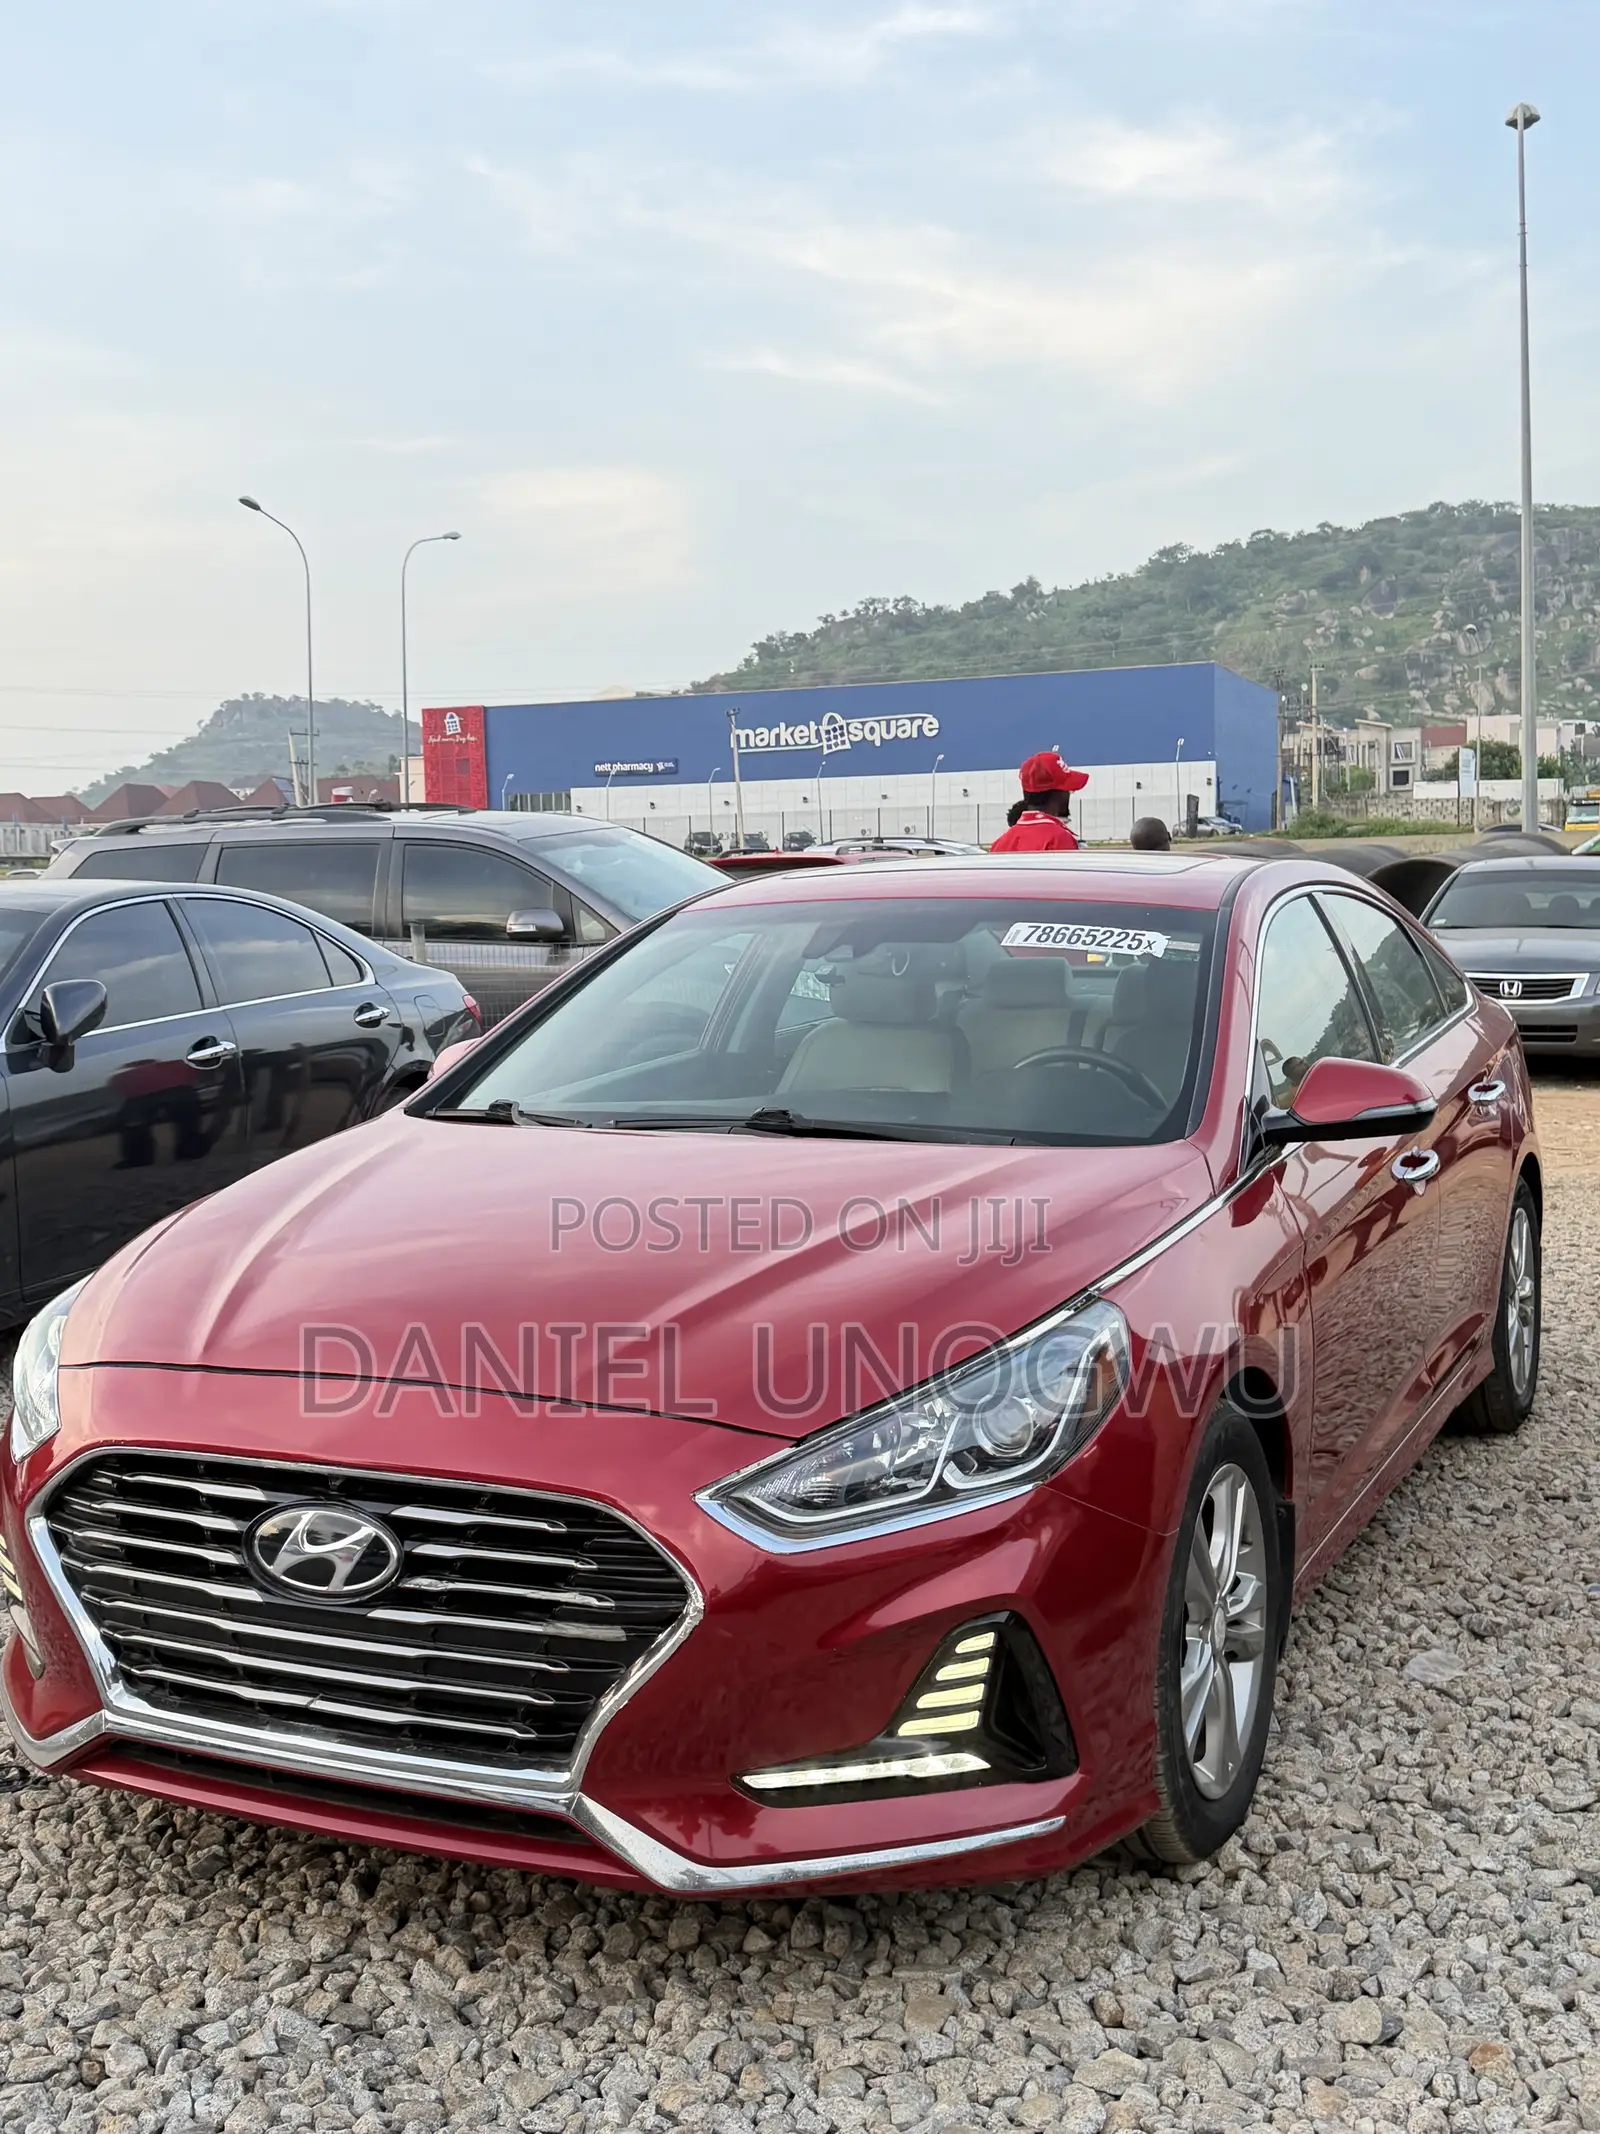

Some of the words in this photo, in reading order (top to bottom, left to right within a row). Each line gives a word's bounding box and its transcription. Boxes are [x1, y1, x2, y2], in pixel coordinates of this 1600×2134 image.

[730, 720, 819, 748] market
[848, 717, 940, 747] square
[594, 763, 611, 772] nett
[612, 762, 654, 773] pharmacy
